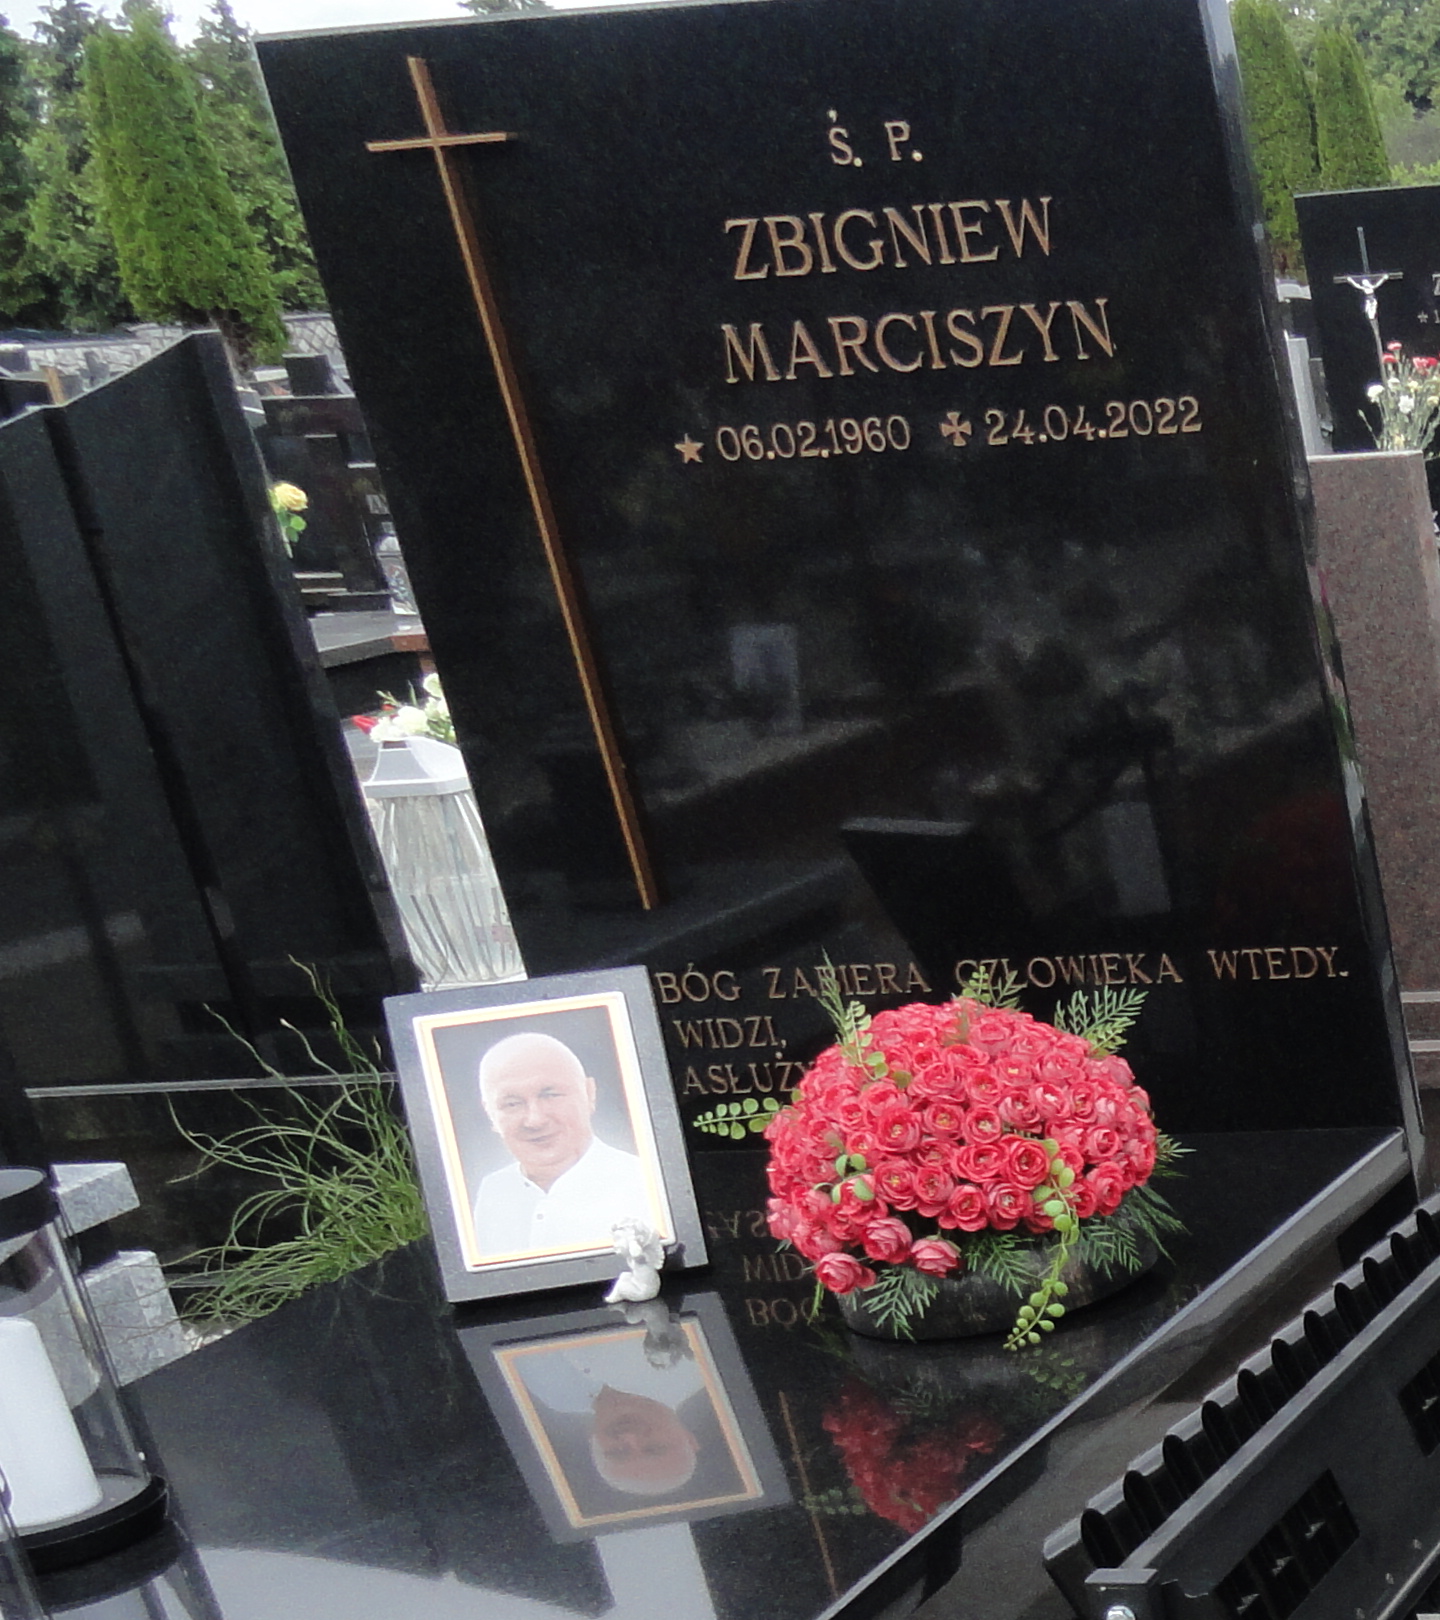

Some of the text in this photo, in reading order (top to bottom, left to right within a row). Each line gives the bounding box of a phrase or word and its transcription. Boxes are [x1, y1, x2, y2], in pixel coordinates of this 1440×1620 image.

[828, 108, 923, 167] Ś. P.
[724, 196, 1053, 280] ZBIGNIEW
[721, 297, 1117, 383] MARCISZYN
[716, 395, 1203, 463] 06.02.1960 24.04.2022
[654, 962, 742, 1005] BÓG
[683, 1051, 816, 1095] ASŁUŻ
